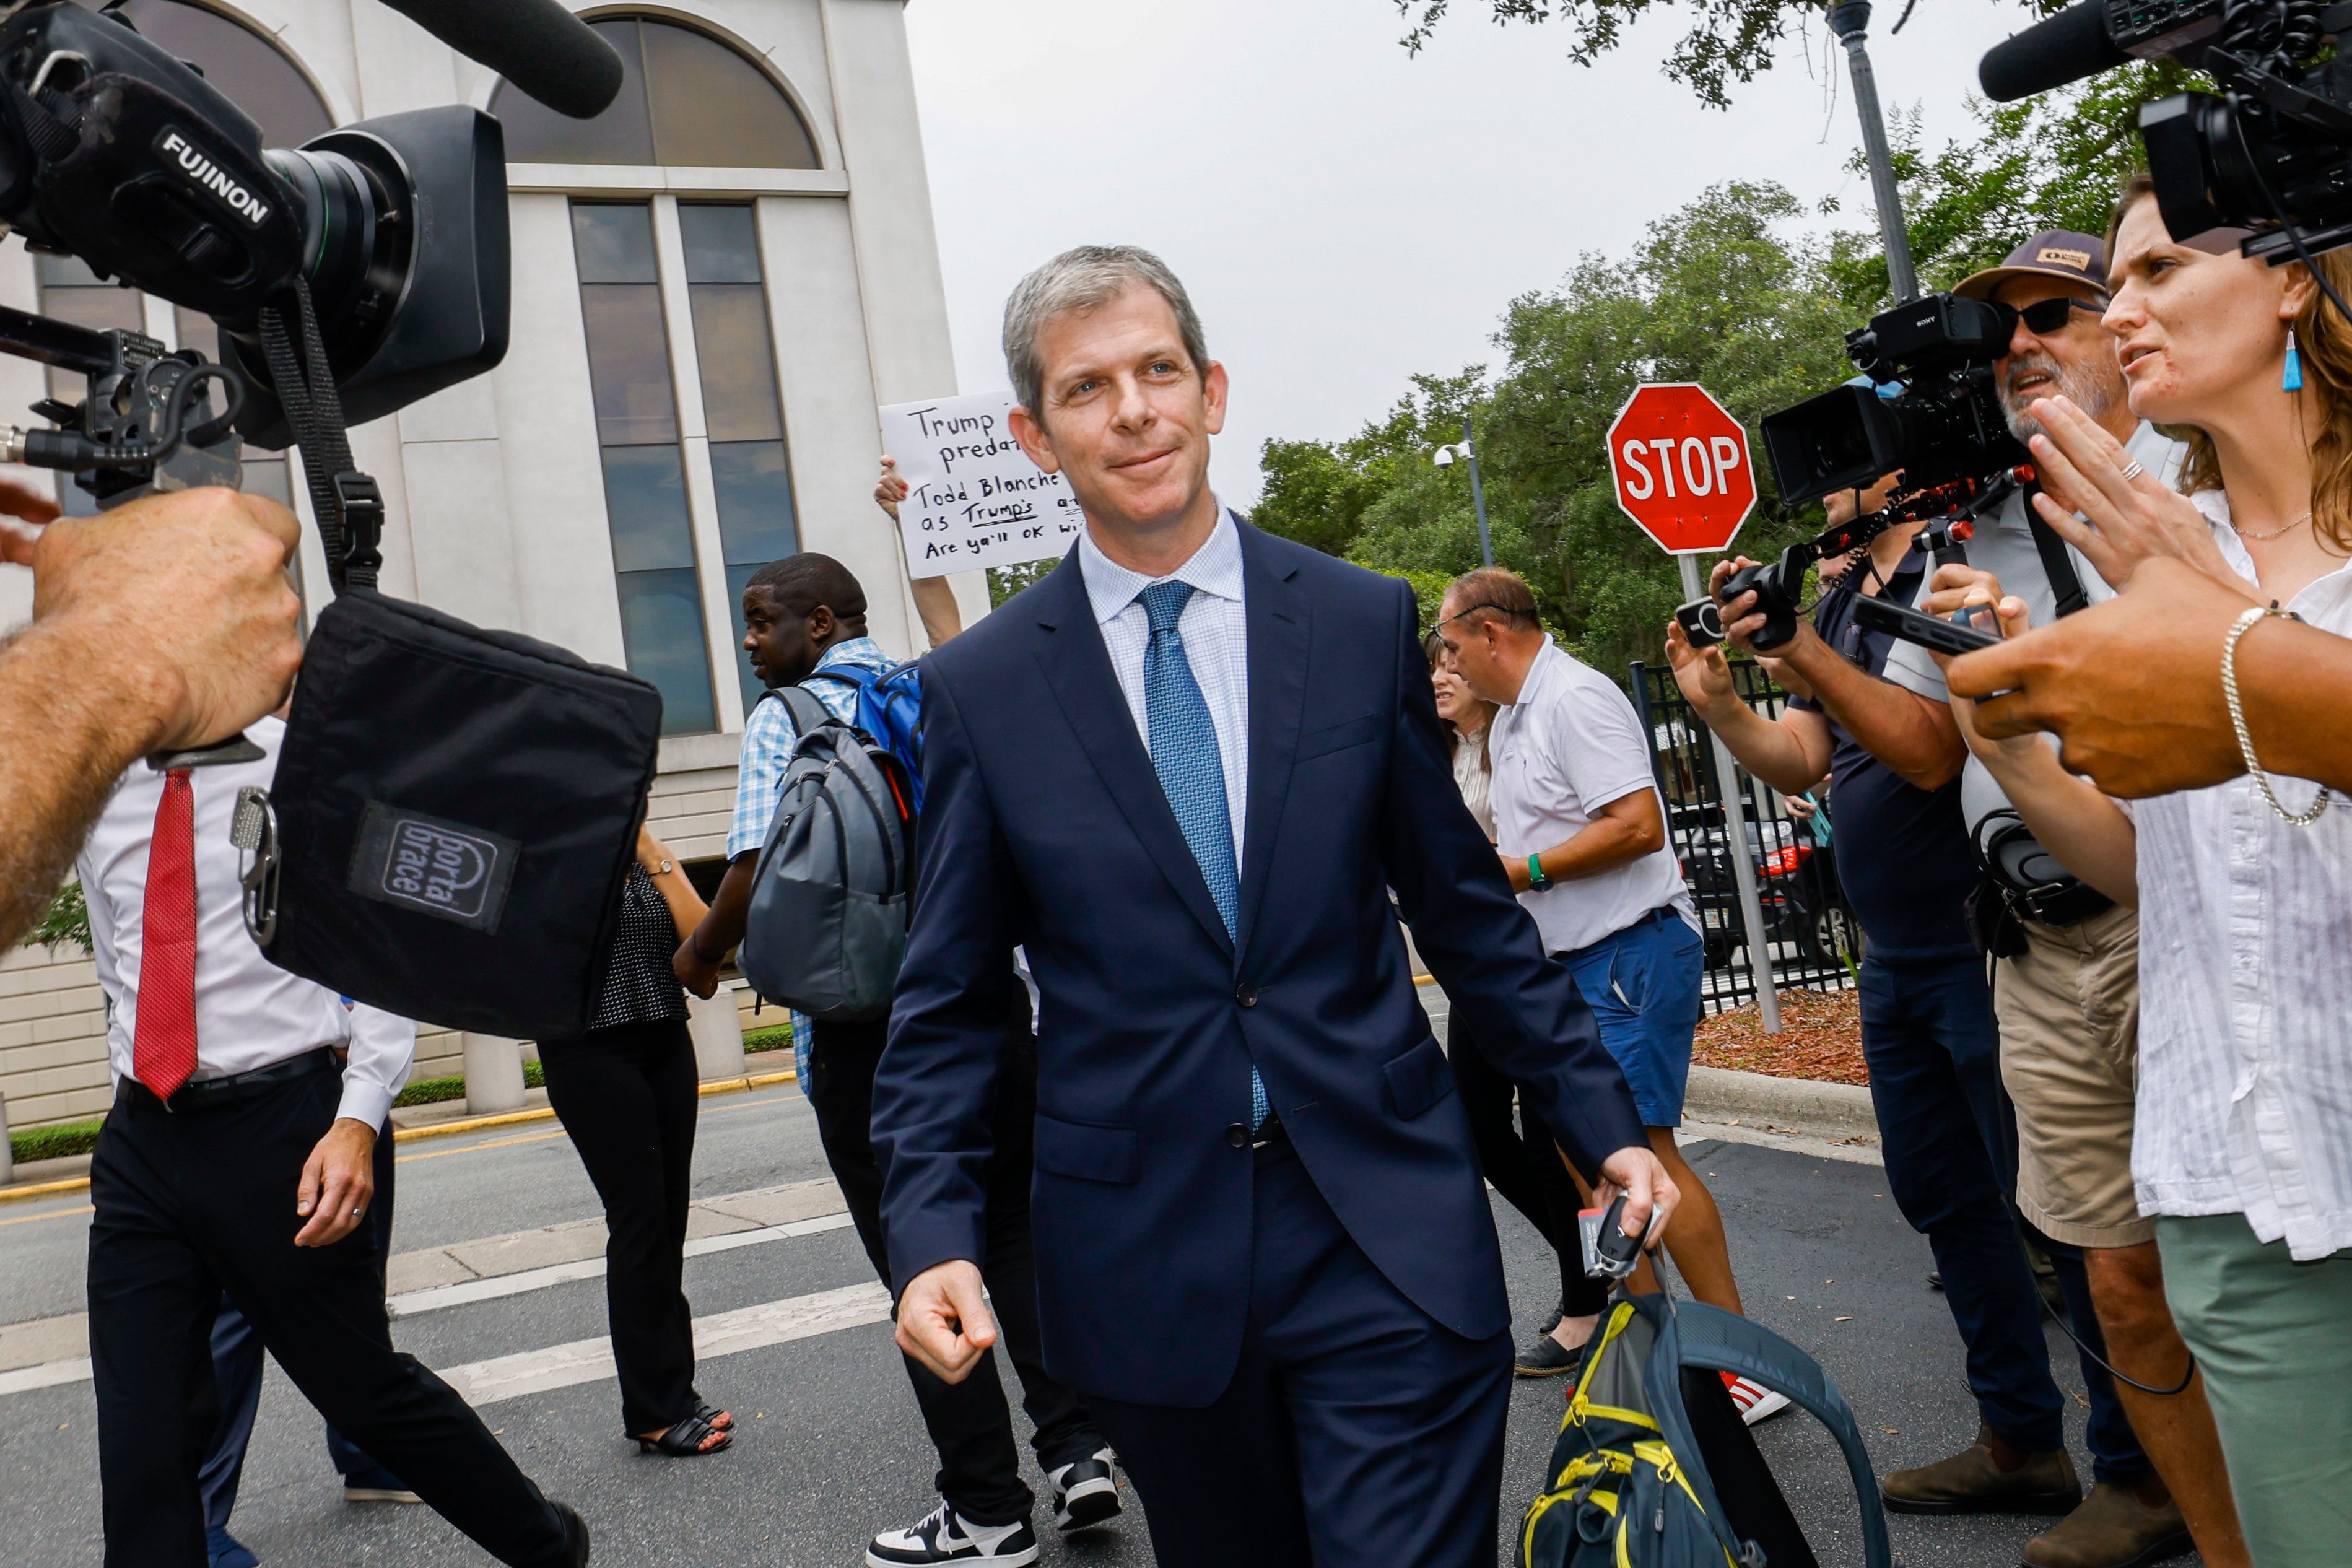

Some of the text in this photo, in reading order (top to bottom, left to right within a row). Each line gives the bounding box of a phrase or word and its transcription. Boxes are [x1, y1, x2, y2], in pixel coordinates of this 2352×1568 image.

[163, 133, 268, 223] FUJINON
[1916, 316, 1935, 327] SONY
[907, 407, 994, 438] Trump
[1622, 436, 1740, 500] STOP
[912, 471, 1060, 508] Todd Blanche
[921, 516, 949, 531] as
[960, 499, 1033, 523] Trump's
[926, 542, 958, 559] Are
[966, 532, 1008, 554] ya'll
[393, 827, 434, 892] brace
